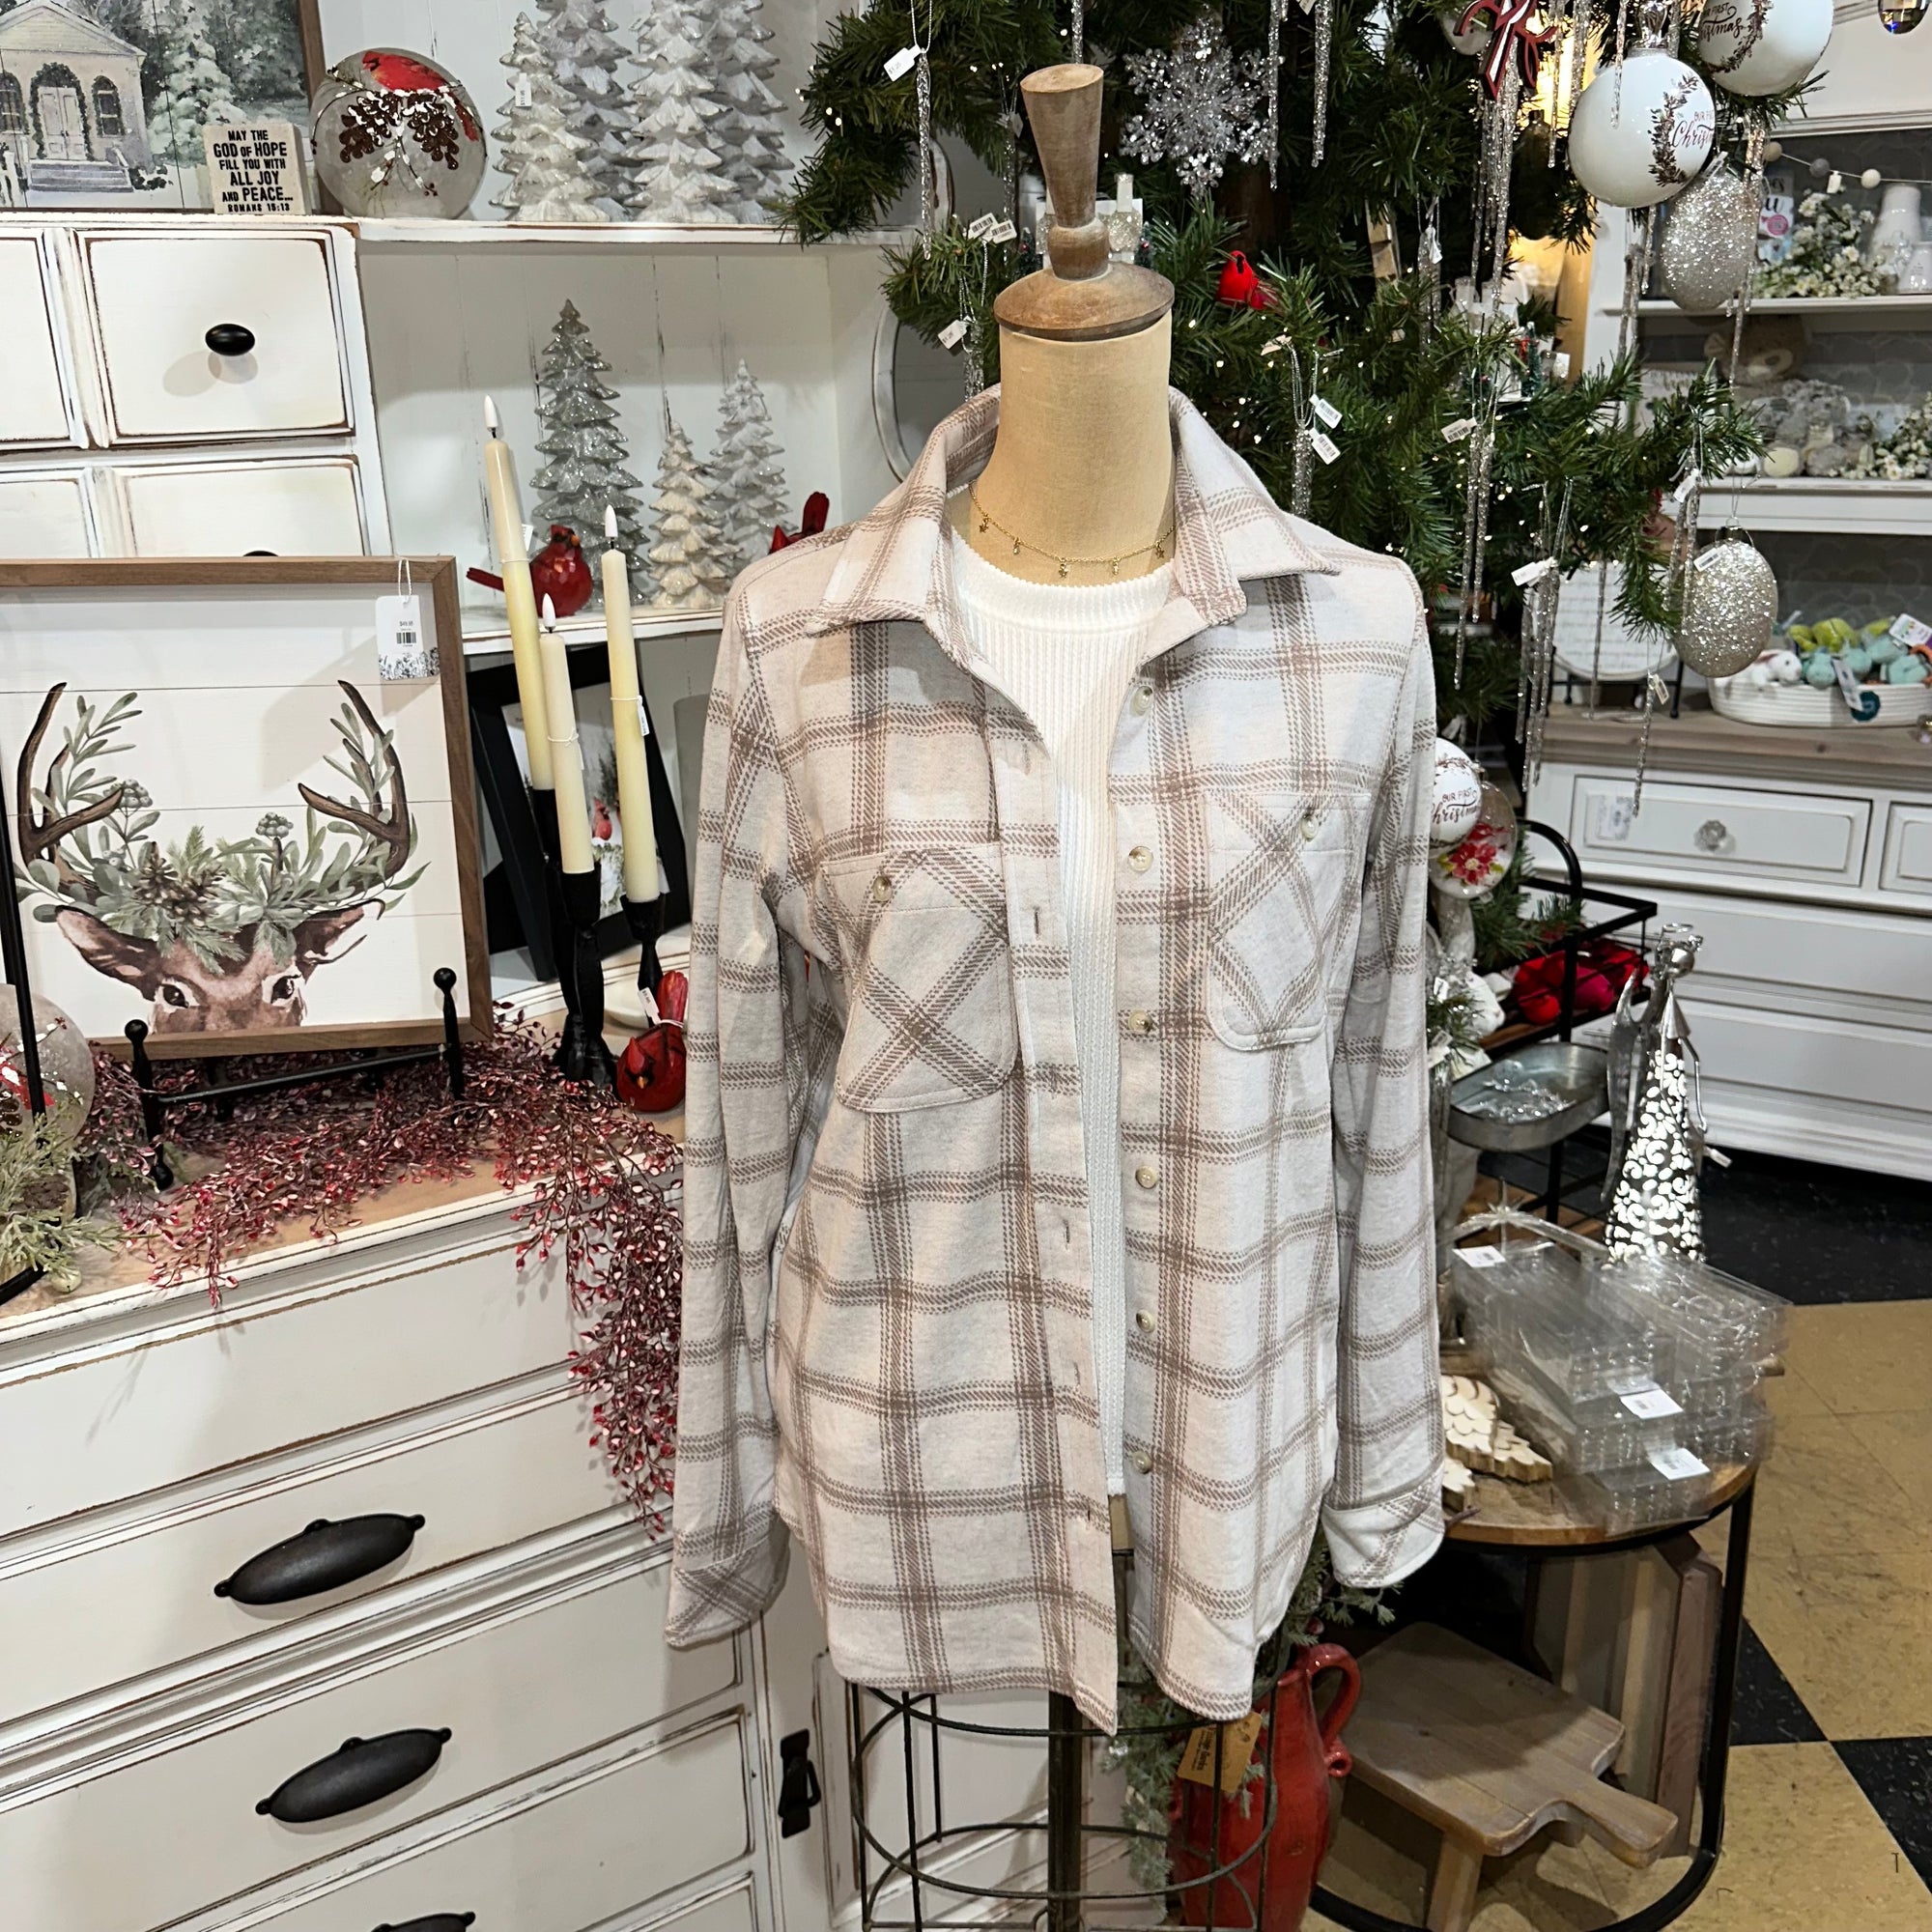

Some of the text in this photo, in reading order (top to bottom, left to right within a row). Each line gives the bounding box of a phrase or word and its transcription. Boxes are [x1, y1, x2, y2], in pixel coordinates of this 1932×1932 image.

[228, 129, 269, 141] MAY THE
[213, 142, 288, 157] GOD OF HOPE
[218, 158, 286, 170] FILL YOU WITH
[230, 170, 279, 185] ALL JOY
[222, 186, 294, 202] AND PEACE...
[228, 203, 290, 213] ROMANS 15:13
